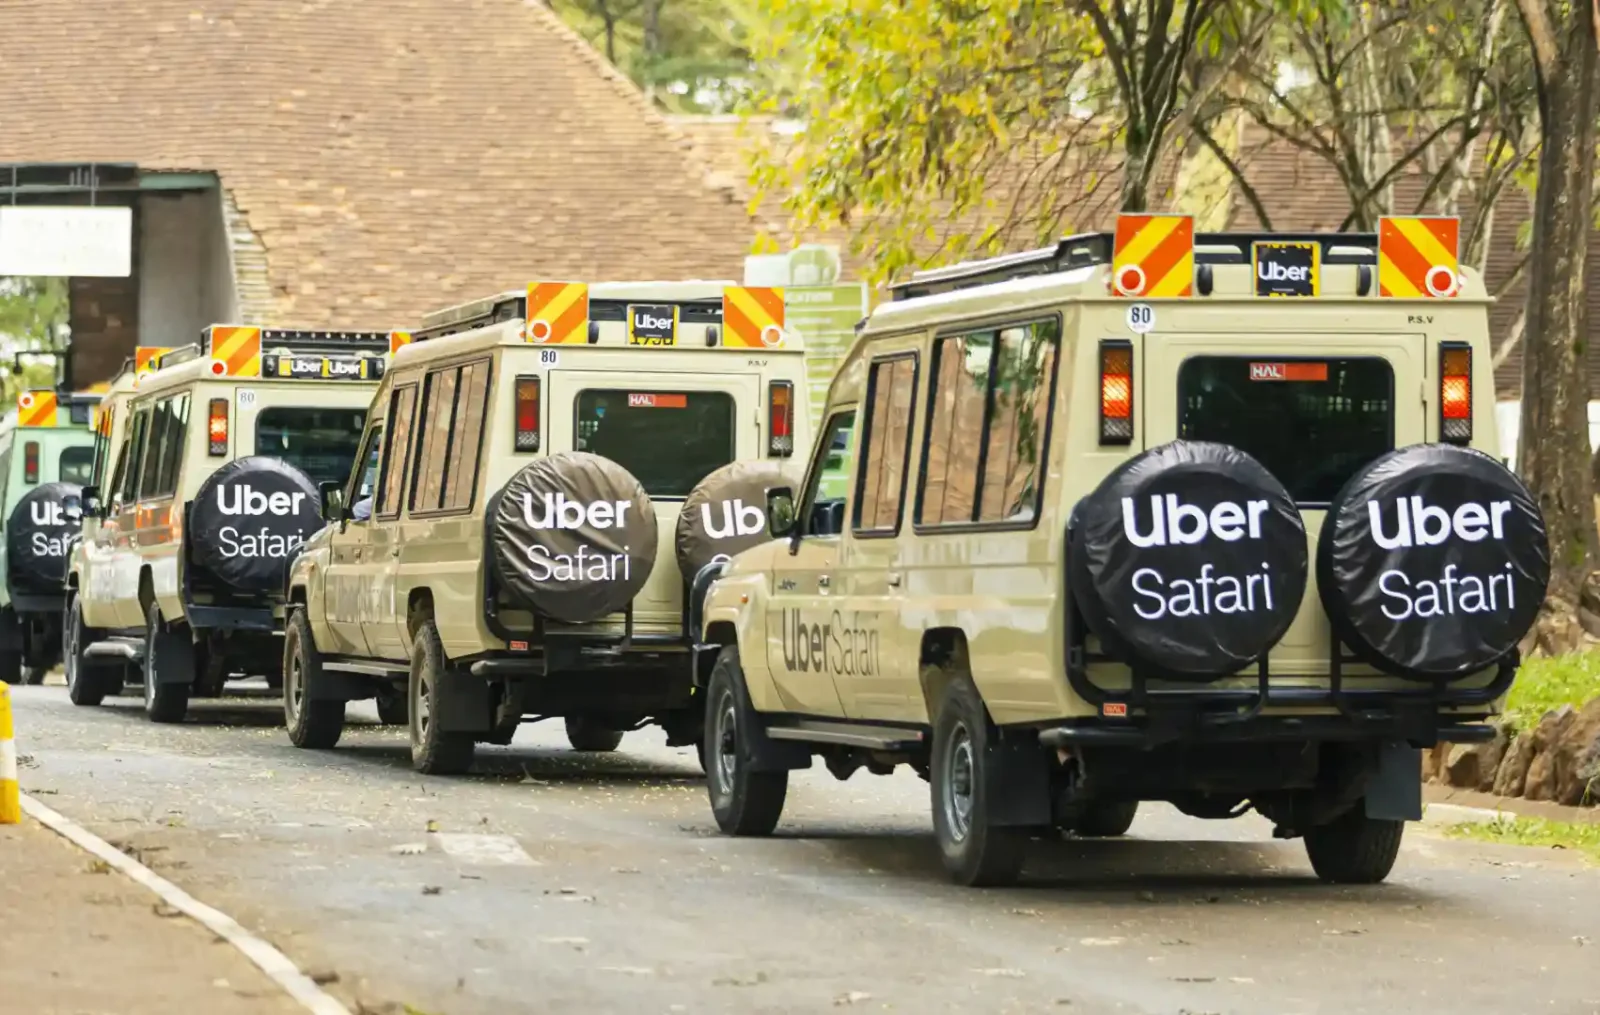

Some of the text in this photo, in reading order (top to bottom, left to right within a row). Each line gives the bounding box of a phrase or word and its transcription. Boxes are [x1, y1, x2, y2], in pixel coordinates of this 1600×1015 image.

[1258, 261, 1309, 281] Uber
[635, 313, 673, 330] Uber
[1131, 306, 1151, 324] 80
[292, 359, 321, 373] Uber
[329, 360, 360, 375] Uber
[541, 350, 556, 363] 80
[1253, 365, 1282, 378] HAL
[240, 391, 255, 403] 80
[217, 484, 306, 516] Uber
[522, 492, 632, 529] Uber
[701, 498, 765, 539] Ub
[1121, 493, 1269, 548] Uber
[1367, 495, 1512, 550] Uber
[32, 531, 70, 557] Saf
[527, 544, 630, 581] Safari
[1131, 561, 1273, 620] Safari
[1378, 561, 1515, 620] Safari
